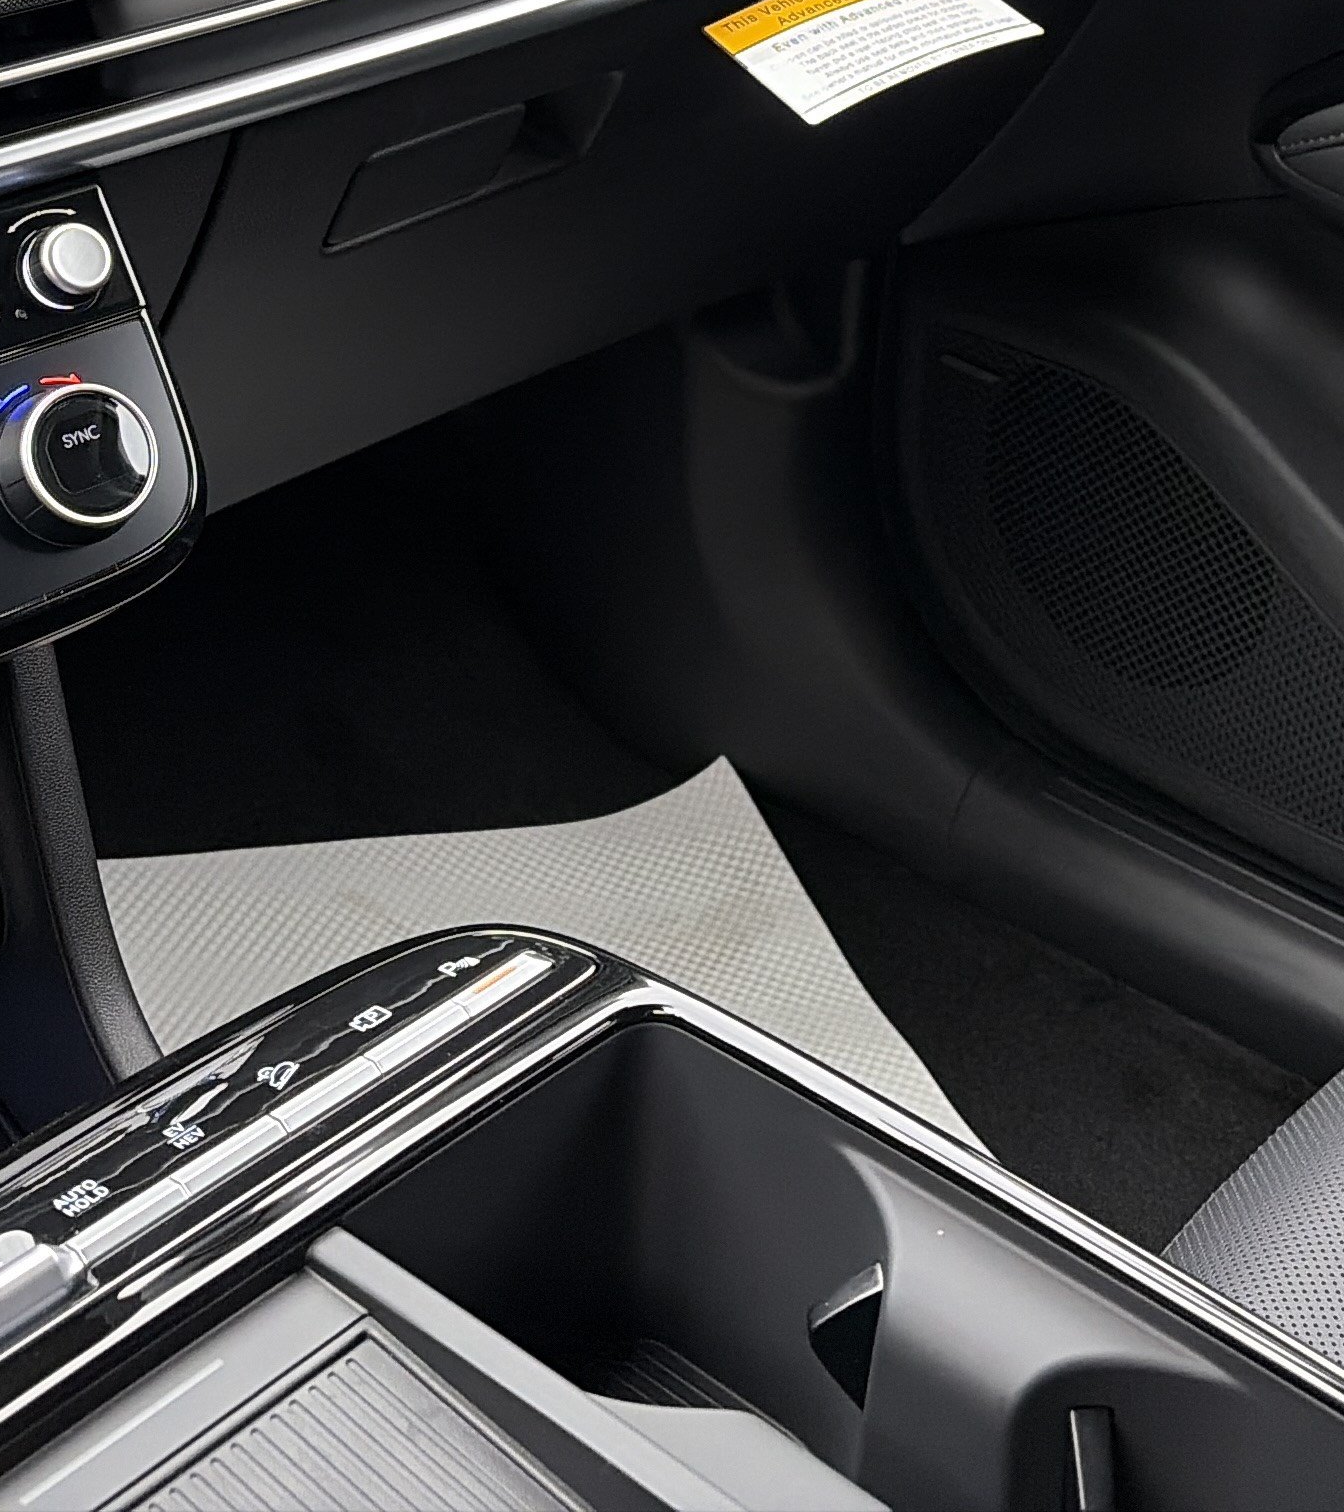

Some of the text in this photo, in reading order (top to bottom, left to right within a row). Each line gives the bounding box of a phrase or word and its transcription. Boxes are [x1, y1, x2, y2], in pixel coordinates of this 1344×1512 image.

[722, 14, 758, 33] This
[771, 34, 806, 52] Even
[809, 19, 839, 34] with
[61, 425, 101, 450] SYNC
[162, 1123, 185, 1137] EV
[173, 1126, 205, 1150] HEV
[53, 1179, 97, 1210] AUTO
[62, 1186, 109, 1217] HOLD
